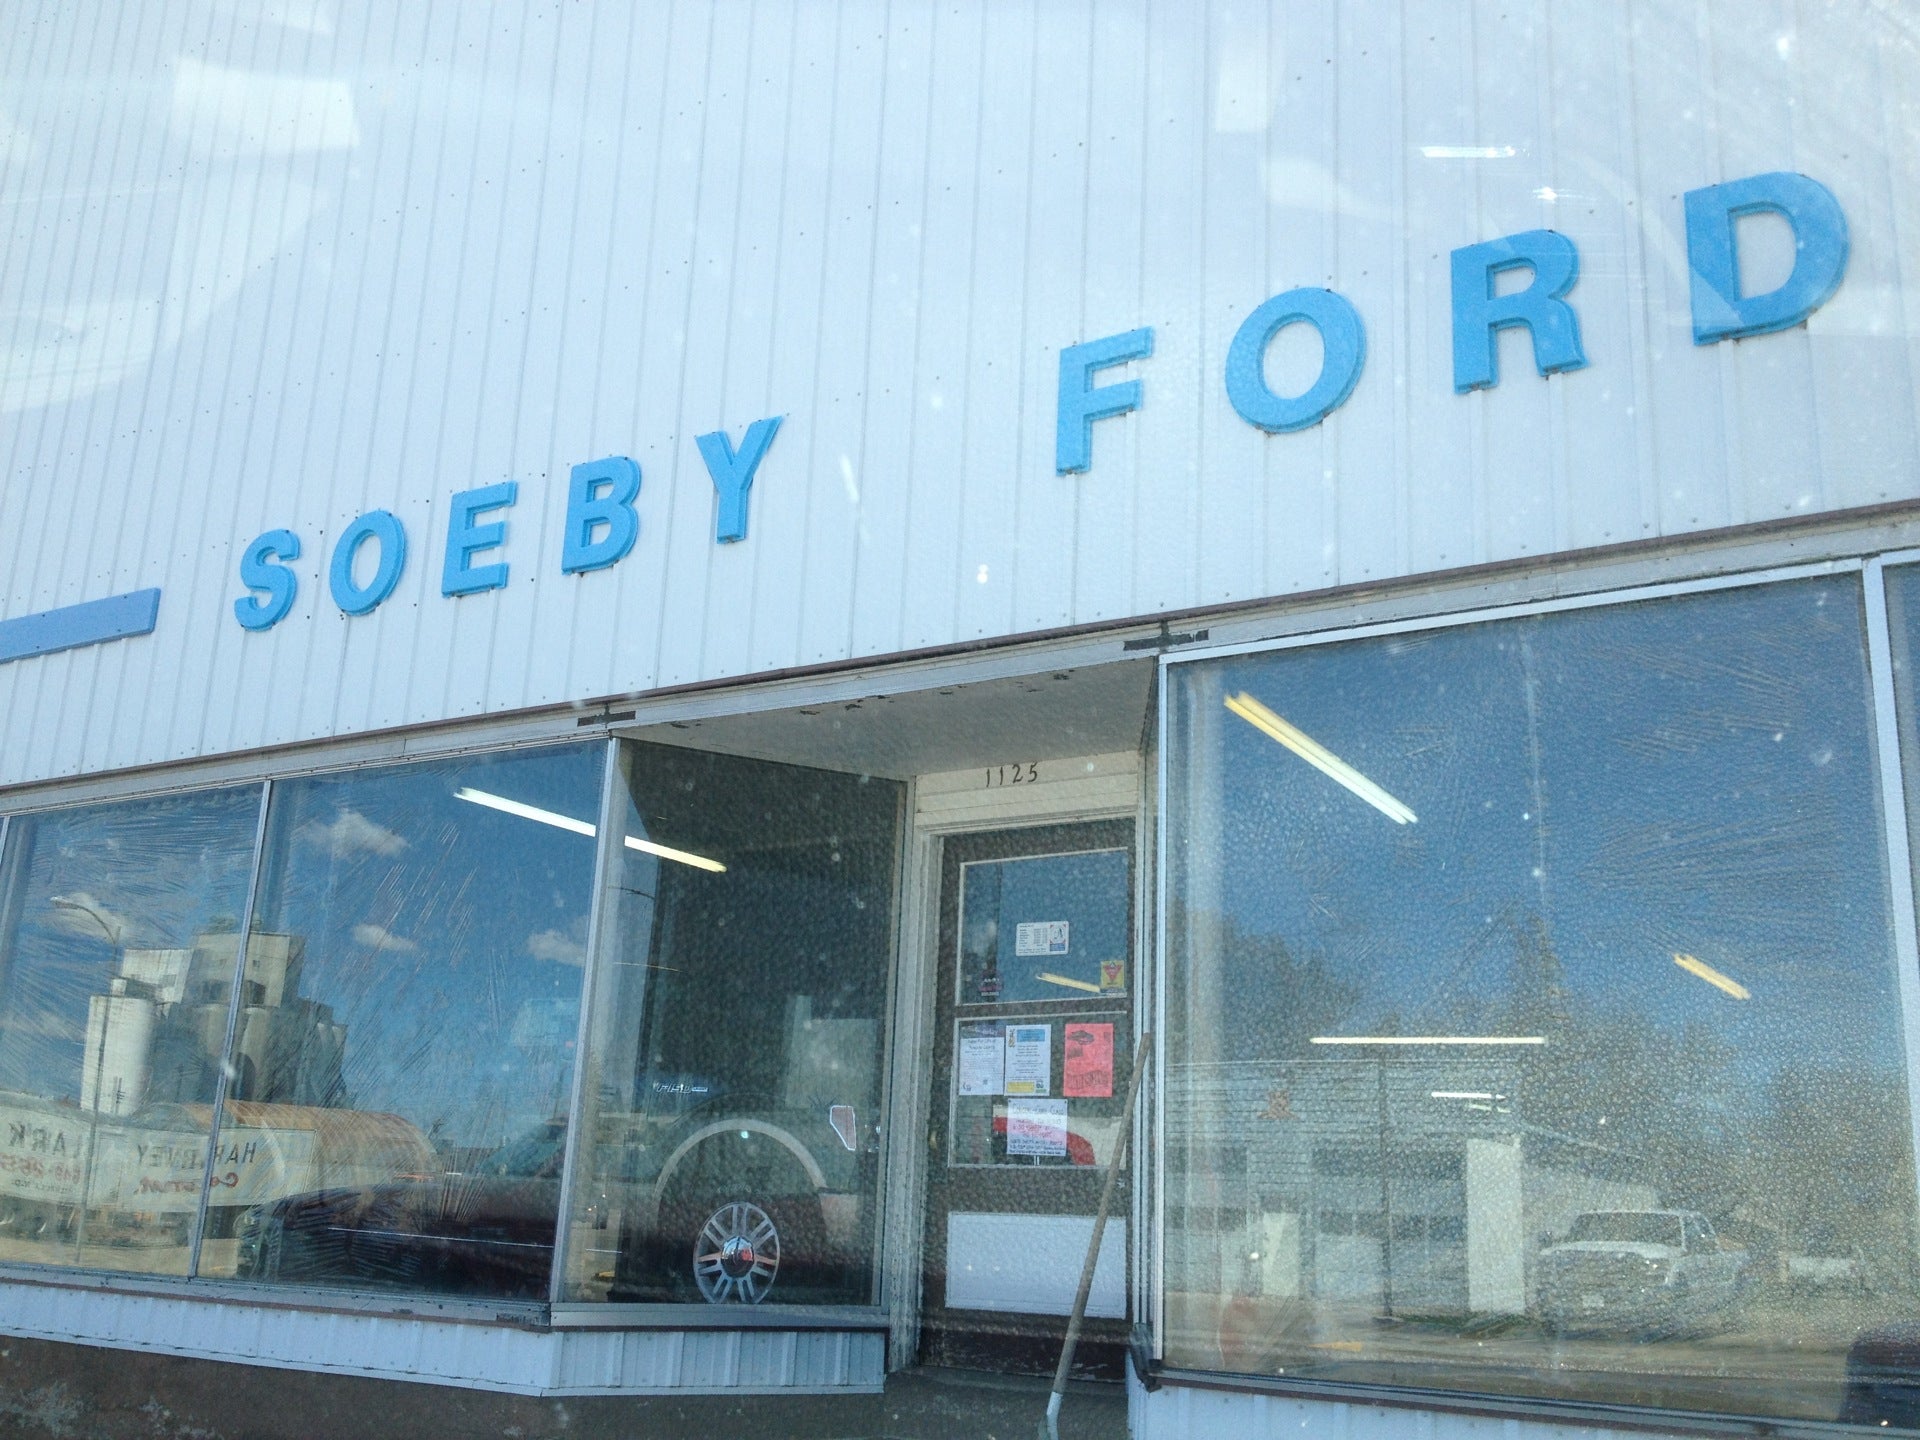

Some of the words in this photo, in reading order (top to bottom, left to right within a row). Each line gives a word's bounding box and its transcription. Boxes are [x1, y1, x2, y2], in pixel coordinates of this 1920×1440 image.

[234, 415, 783, 632] SOEBY
[1056, 171, 1850, 476] FORD
[986, 761, 1038, 788] 1125
